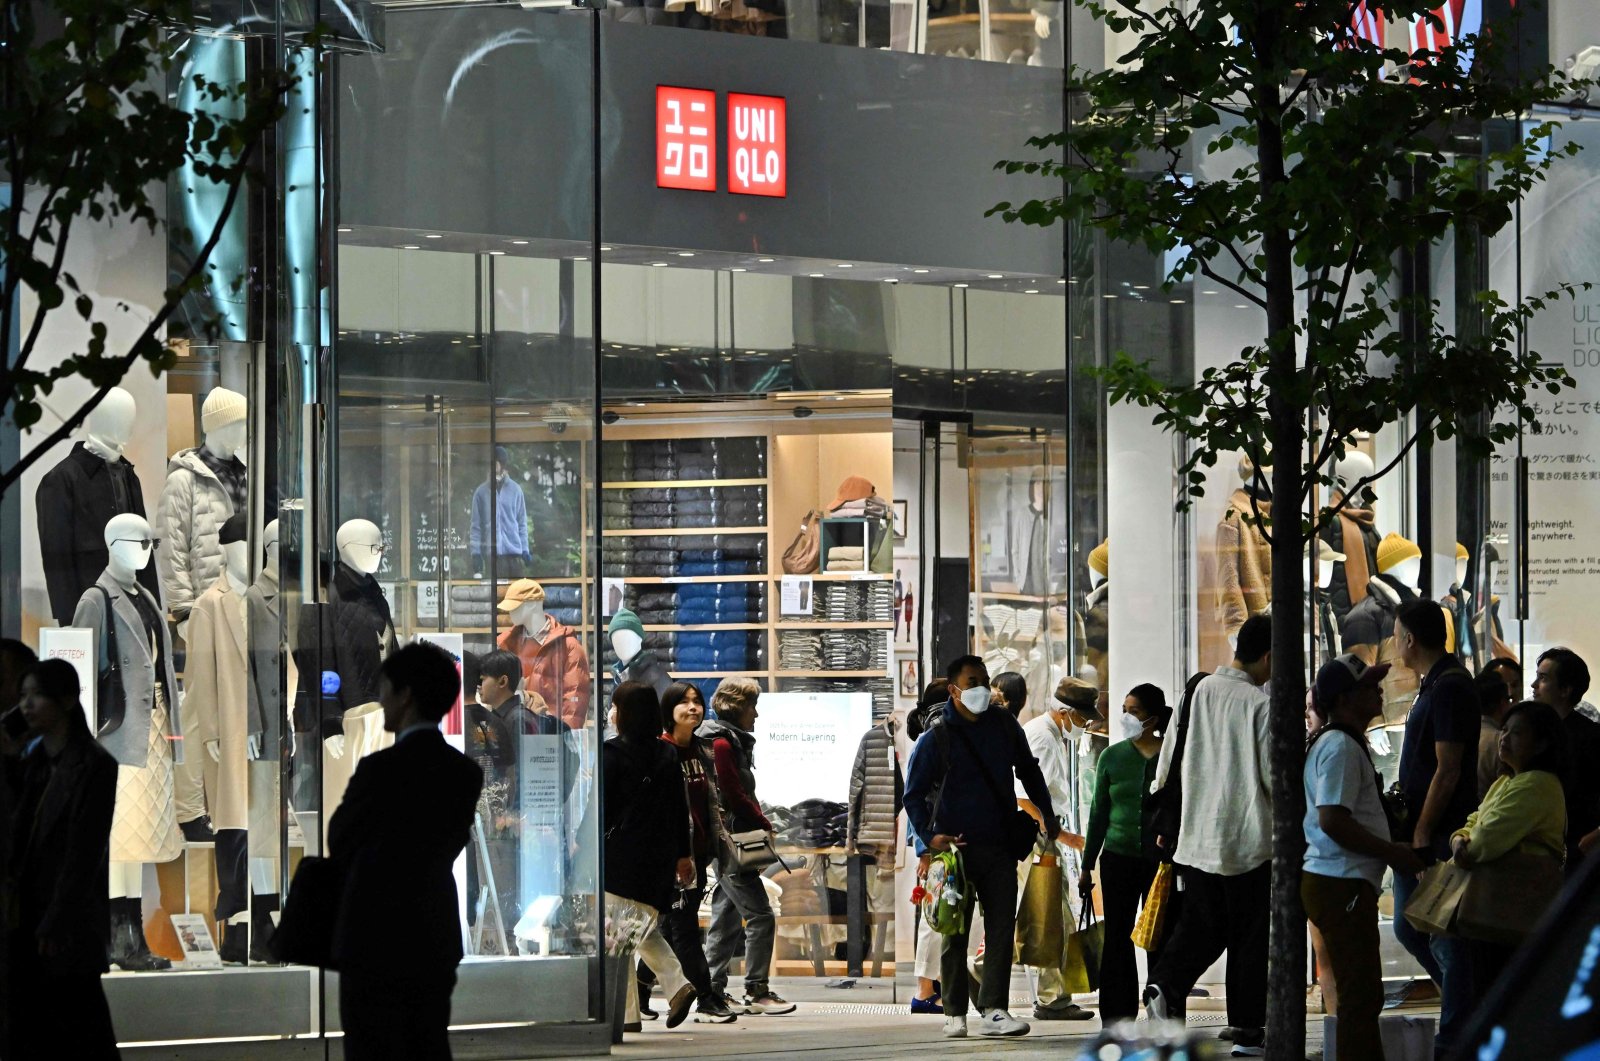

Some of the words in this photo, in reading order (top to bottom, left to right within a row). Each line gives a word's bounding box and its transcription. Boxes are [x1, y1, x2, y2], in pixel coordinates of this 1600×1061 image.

[735, 106, 775, 143] UNI
[735, 147, 779, 188] QLO
[1531, 532, 1576, 541] anywhere.
[769, 732, 798, 741] Modern
[801, 732, 836, 743] Layering
